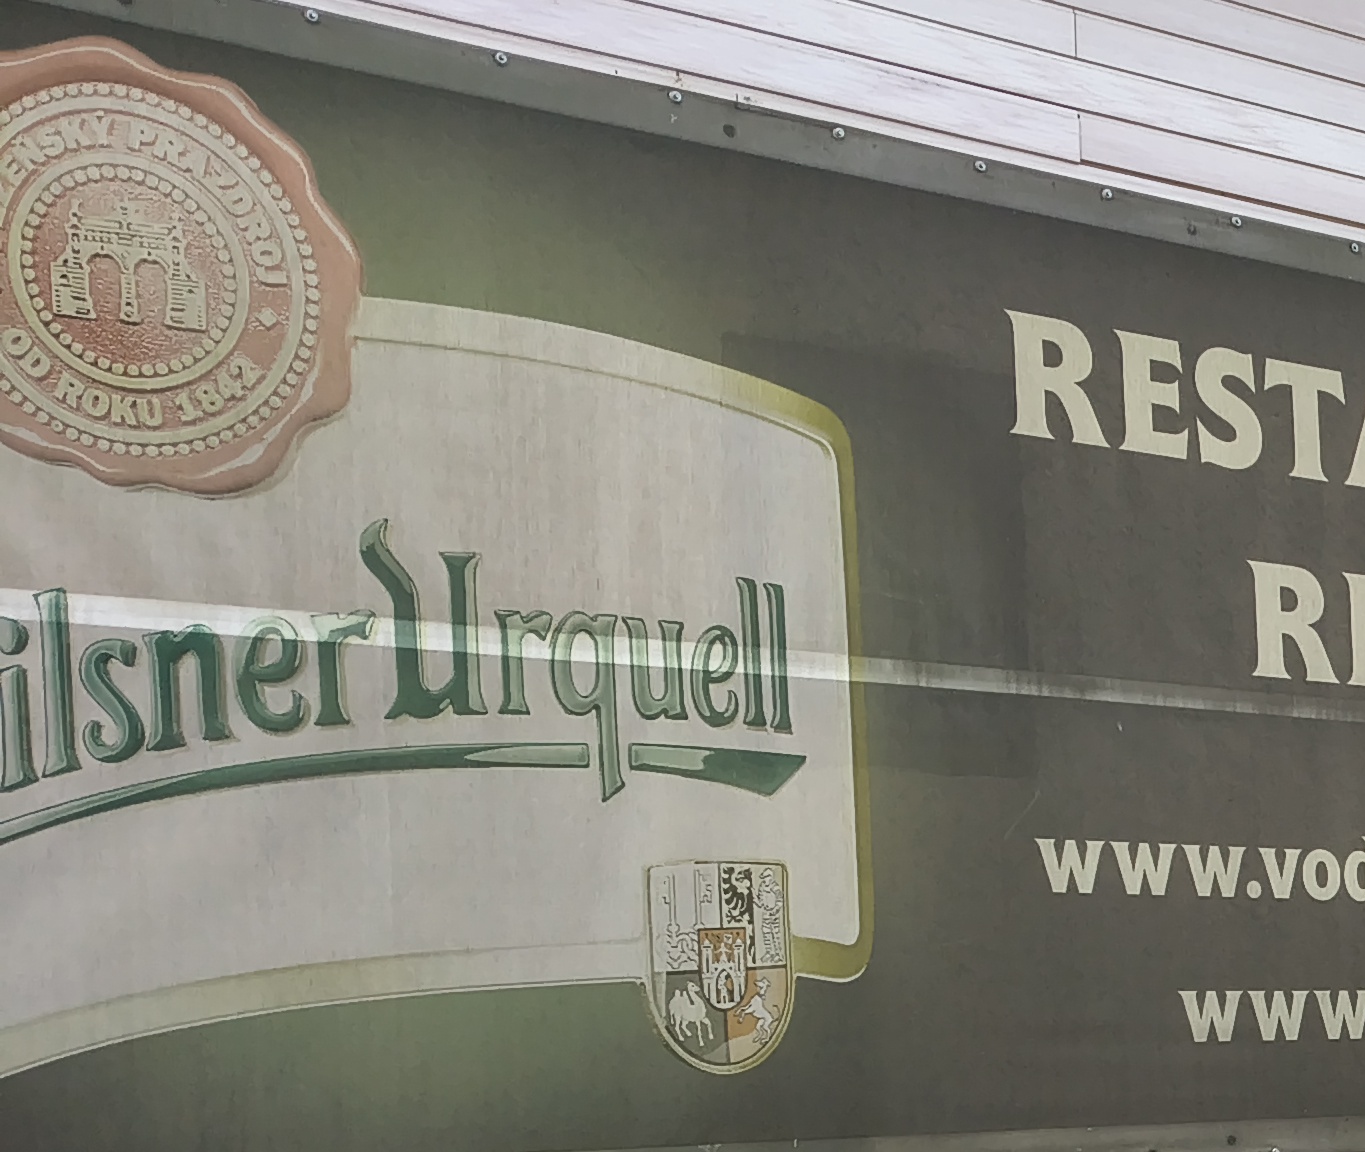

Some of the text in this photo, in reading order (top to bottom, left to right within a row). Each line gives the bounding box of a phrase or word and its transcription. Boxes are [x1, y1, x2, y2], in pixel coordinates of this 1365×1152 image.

[1, 328, 262, 427] OD ROKU 1842
[0, 518, 794, 803] ilsner Urquell
